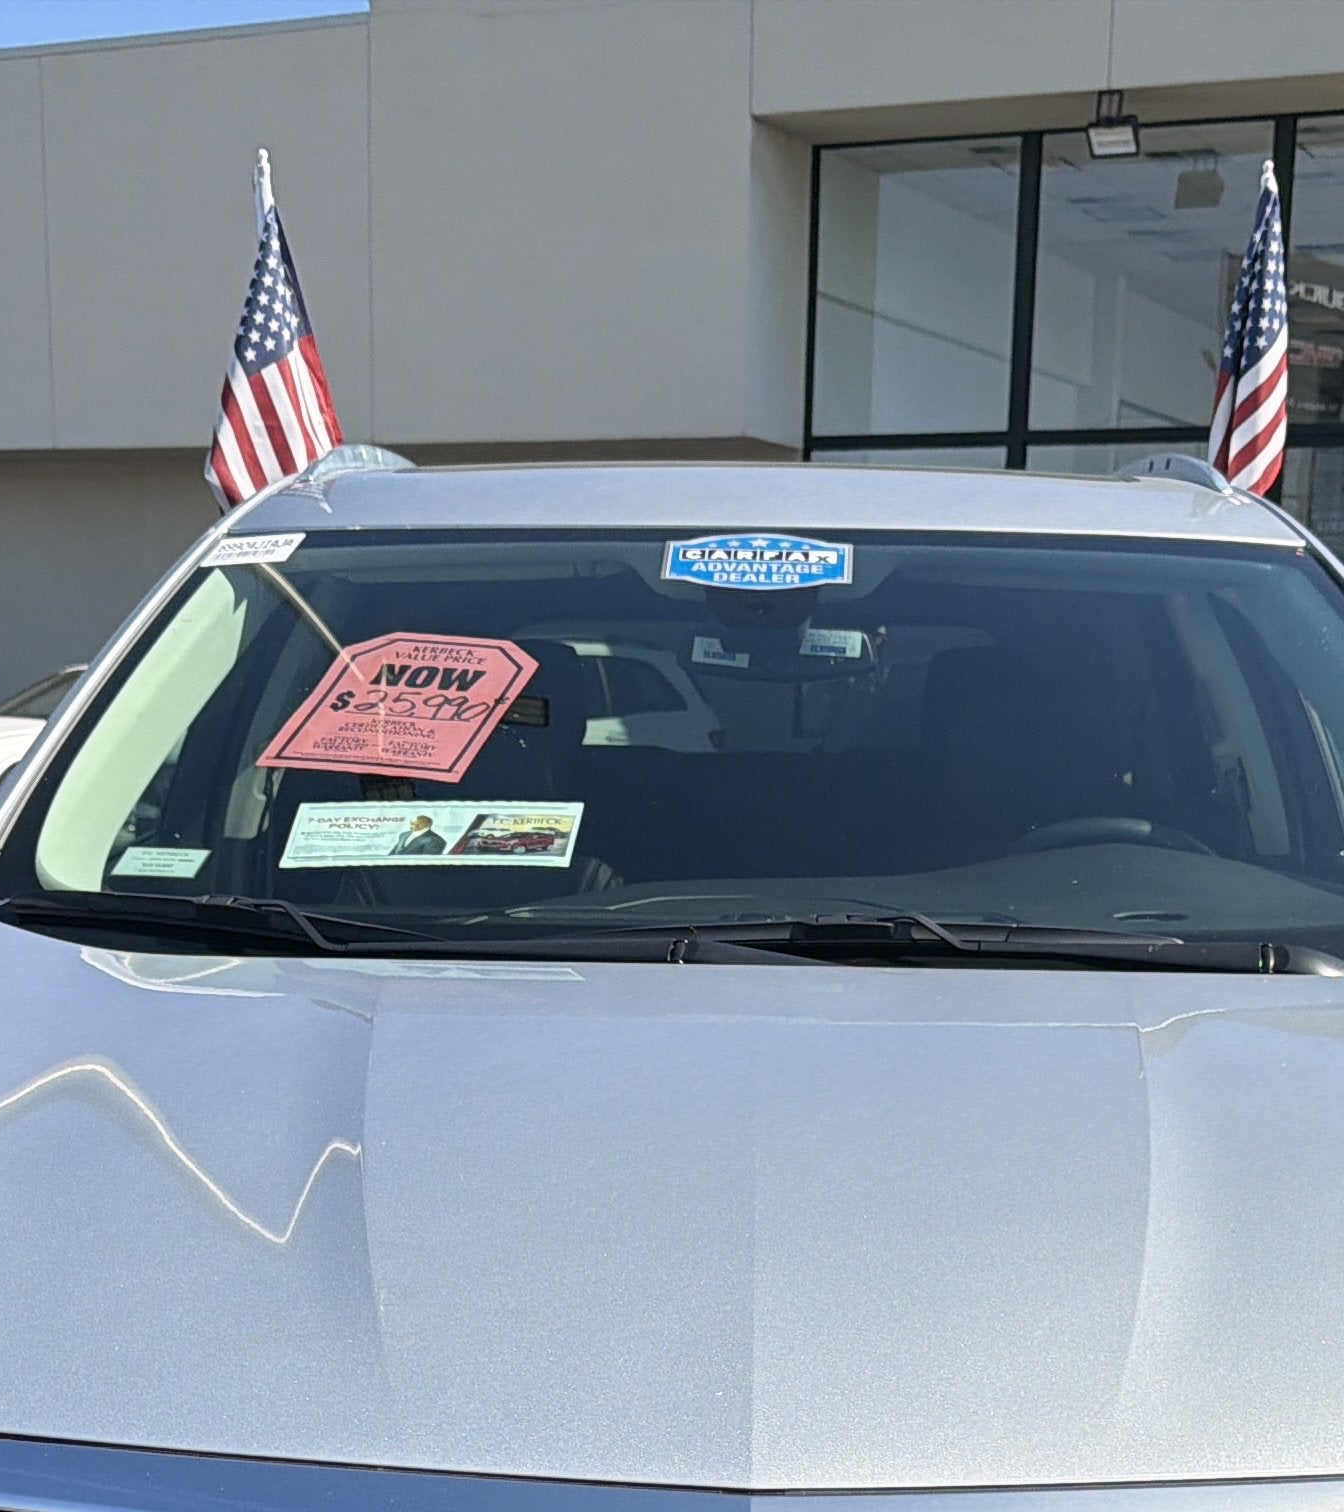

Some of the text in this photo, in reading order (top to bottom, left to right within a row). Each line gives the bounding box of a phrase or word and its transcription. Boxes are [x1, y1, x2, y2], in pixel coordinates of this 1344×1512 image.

[682, 549, 835, 564] CARFAX
[691, 562, 824, 574] ADVANTAGE
[713, 572, 800, 583] DEALER
[370, 663, 487, 692] NOW
